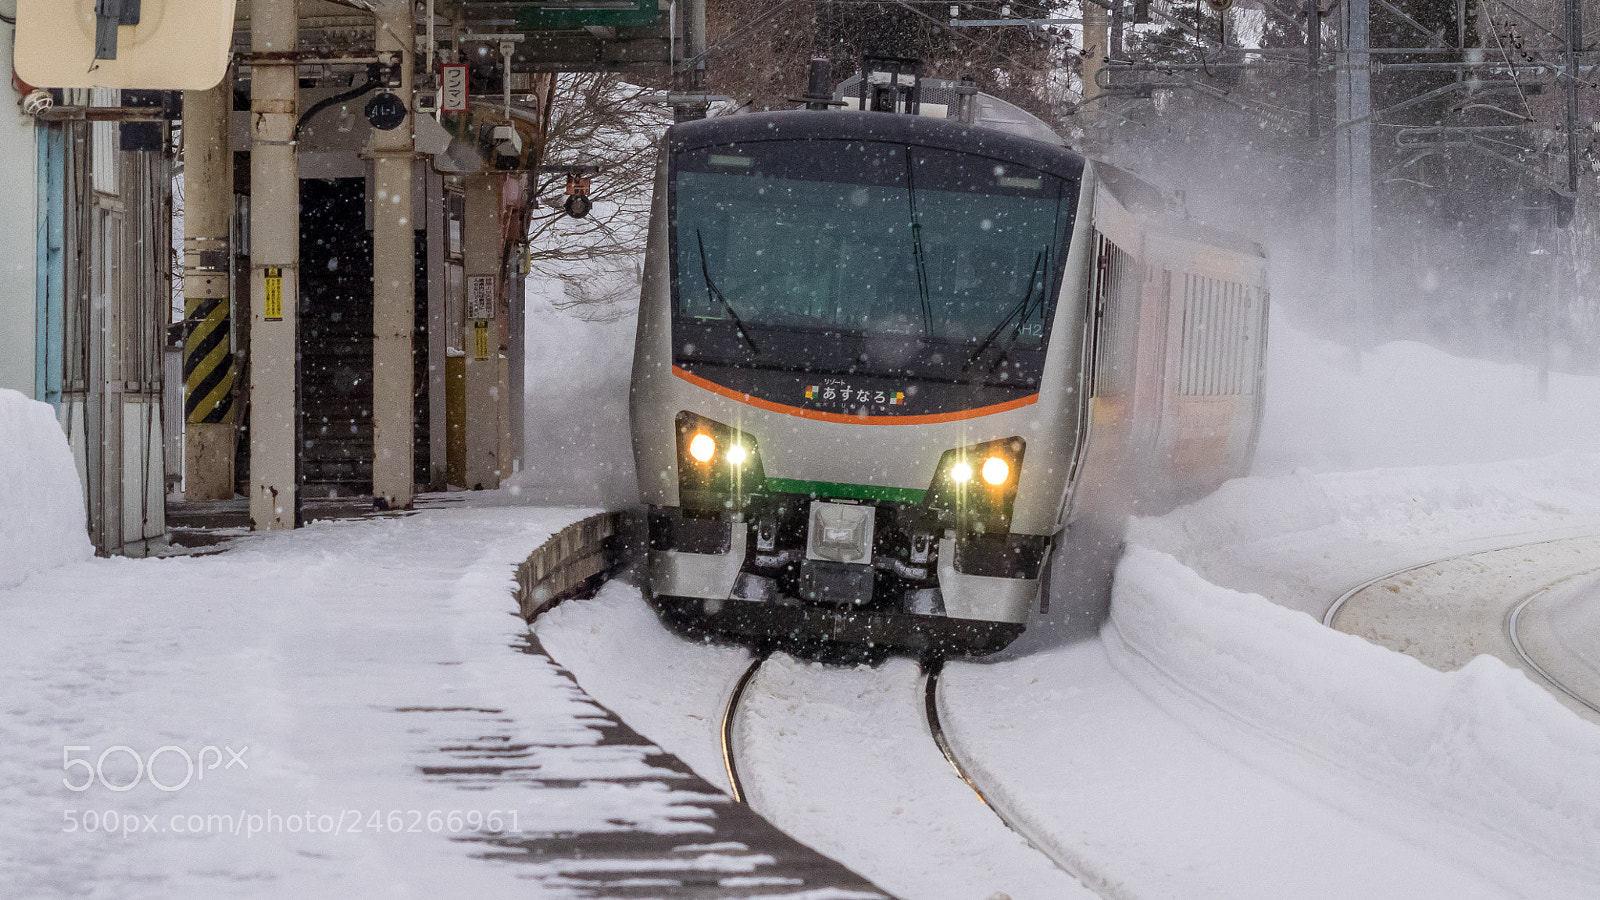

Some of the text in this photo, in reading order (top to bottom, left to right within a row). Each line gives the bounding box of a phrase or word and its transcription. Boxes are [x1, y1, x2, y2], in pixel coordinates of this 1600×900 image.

[448, 69, 461, 108] ワンマン
[824, 378, 846, 386] リゾート
[823, 386, 886, 404] あすなろ
